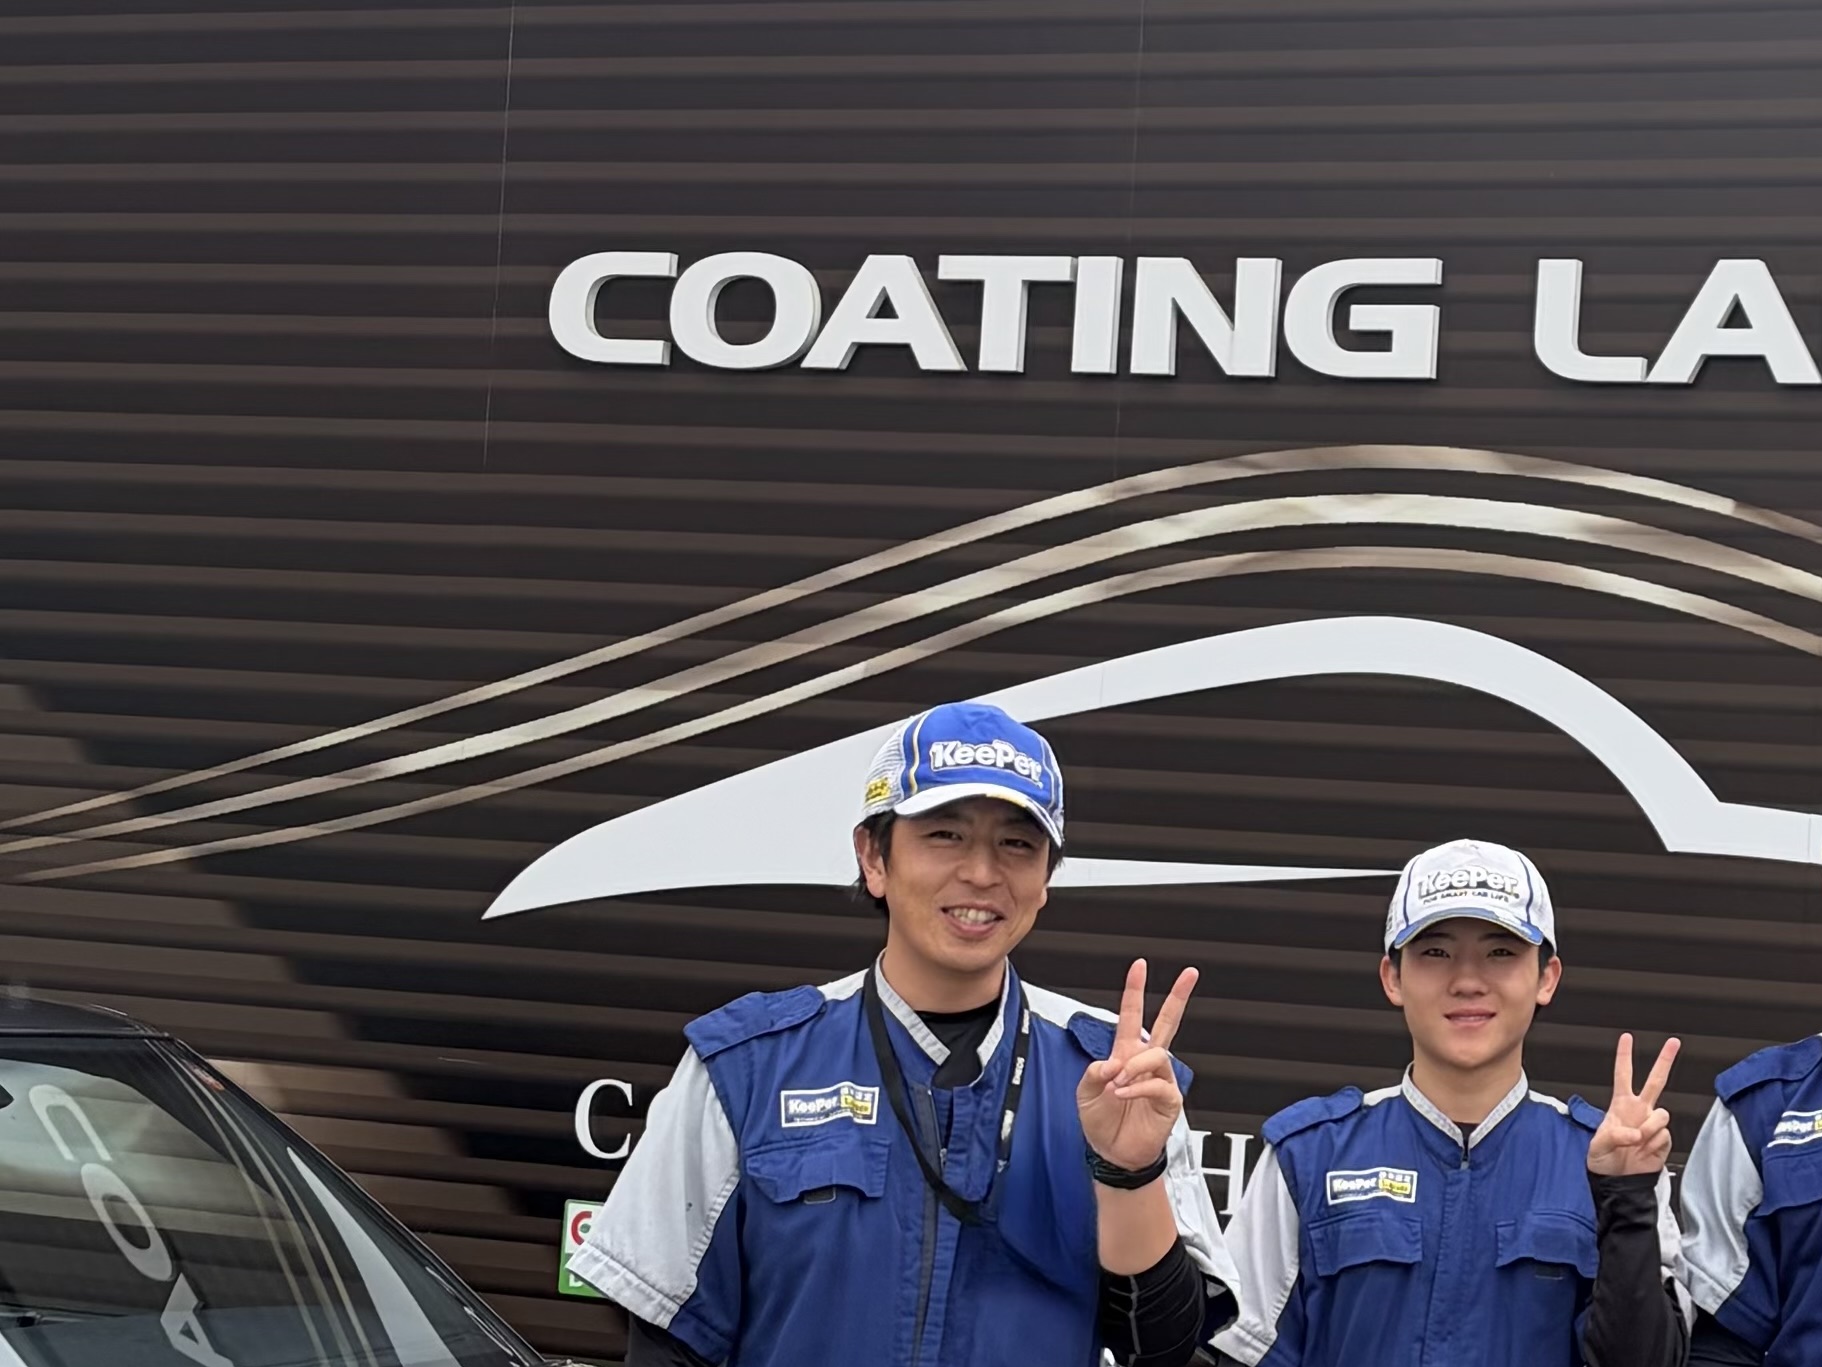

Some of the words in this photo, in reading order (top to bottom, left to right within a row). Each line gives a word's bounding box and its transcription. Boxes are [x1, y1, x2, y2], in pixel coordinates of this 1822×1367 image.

[547, 250, 1442, 382] COATING
[932, 741, 1042, 783] KeePer
[1418, 866, 1519, 899] KeePer
